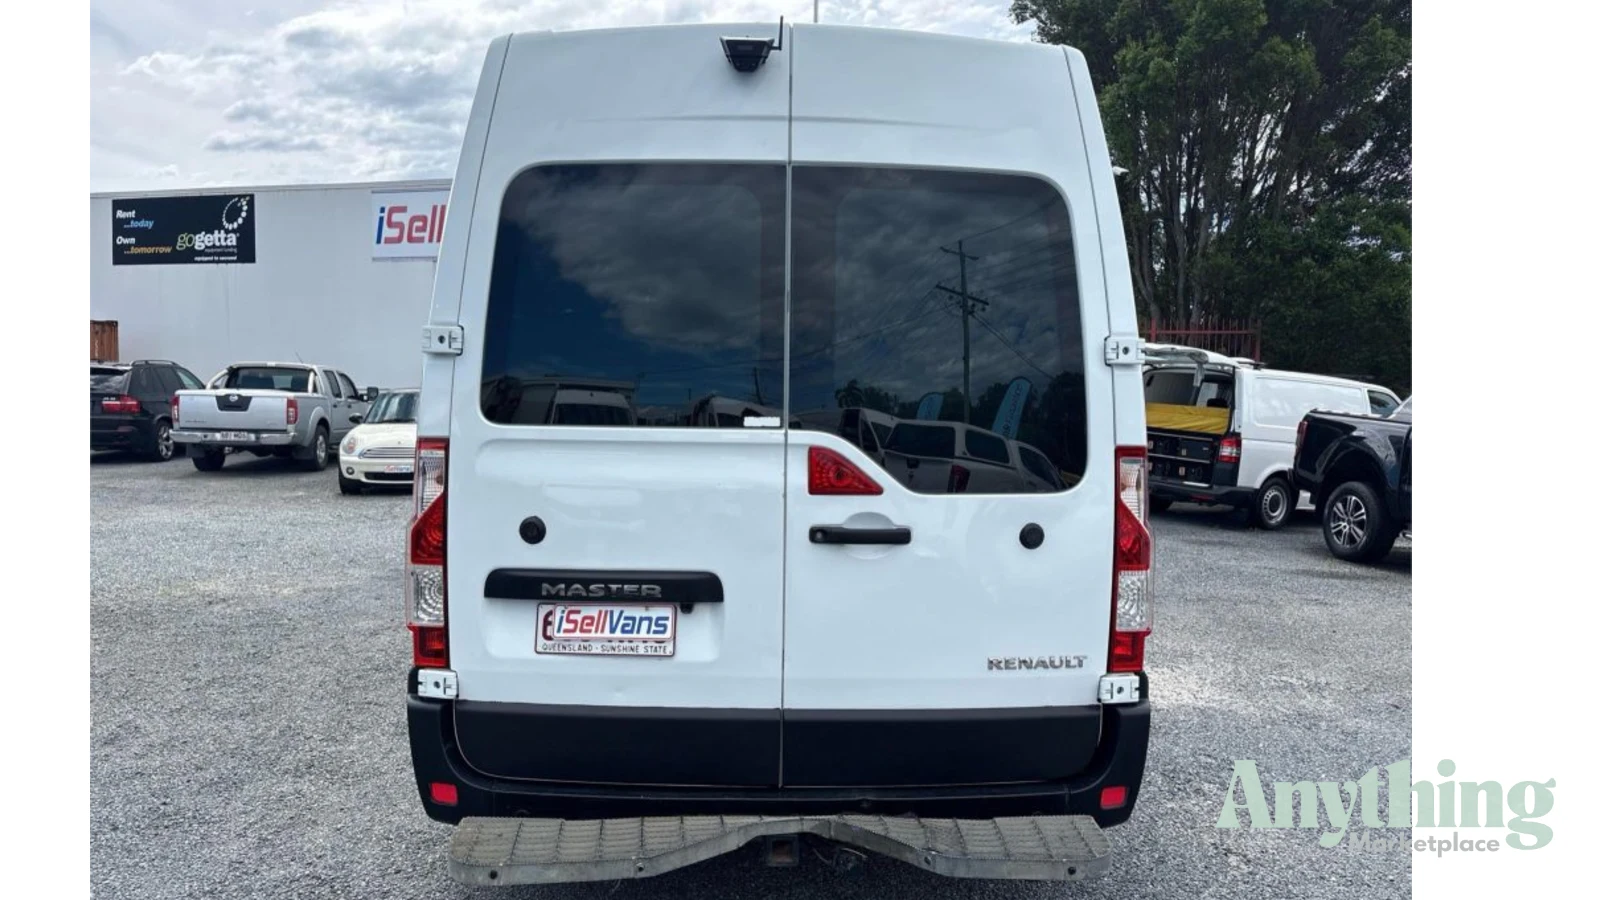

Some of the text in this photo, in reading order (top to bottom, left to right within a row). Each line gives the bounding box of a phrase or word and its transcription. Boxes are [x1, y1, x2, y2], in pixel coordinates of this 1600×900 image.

[116, 209, 136, 219] Rent
[376, 204, 447, 244] iSell
[116, 236, 136, 245] Own
[176, 229, 238, 250] gogetta
[541, 583, 662, 598] MASTER
[556, 609, 670, 635] iSellVans
[541, 642, 593, 652] QUEENSLAND
[600, 644, 640, 653] SUNSHINE
[643, 645, 667, 654] STATE
[987, 655, 1088, 671] RENAULT
